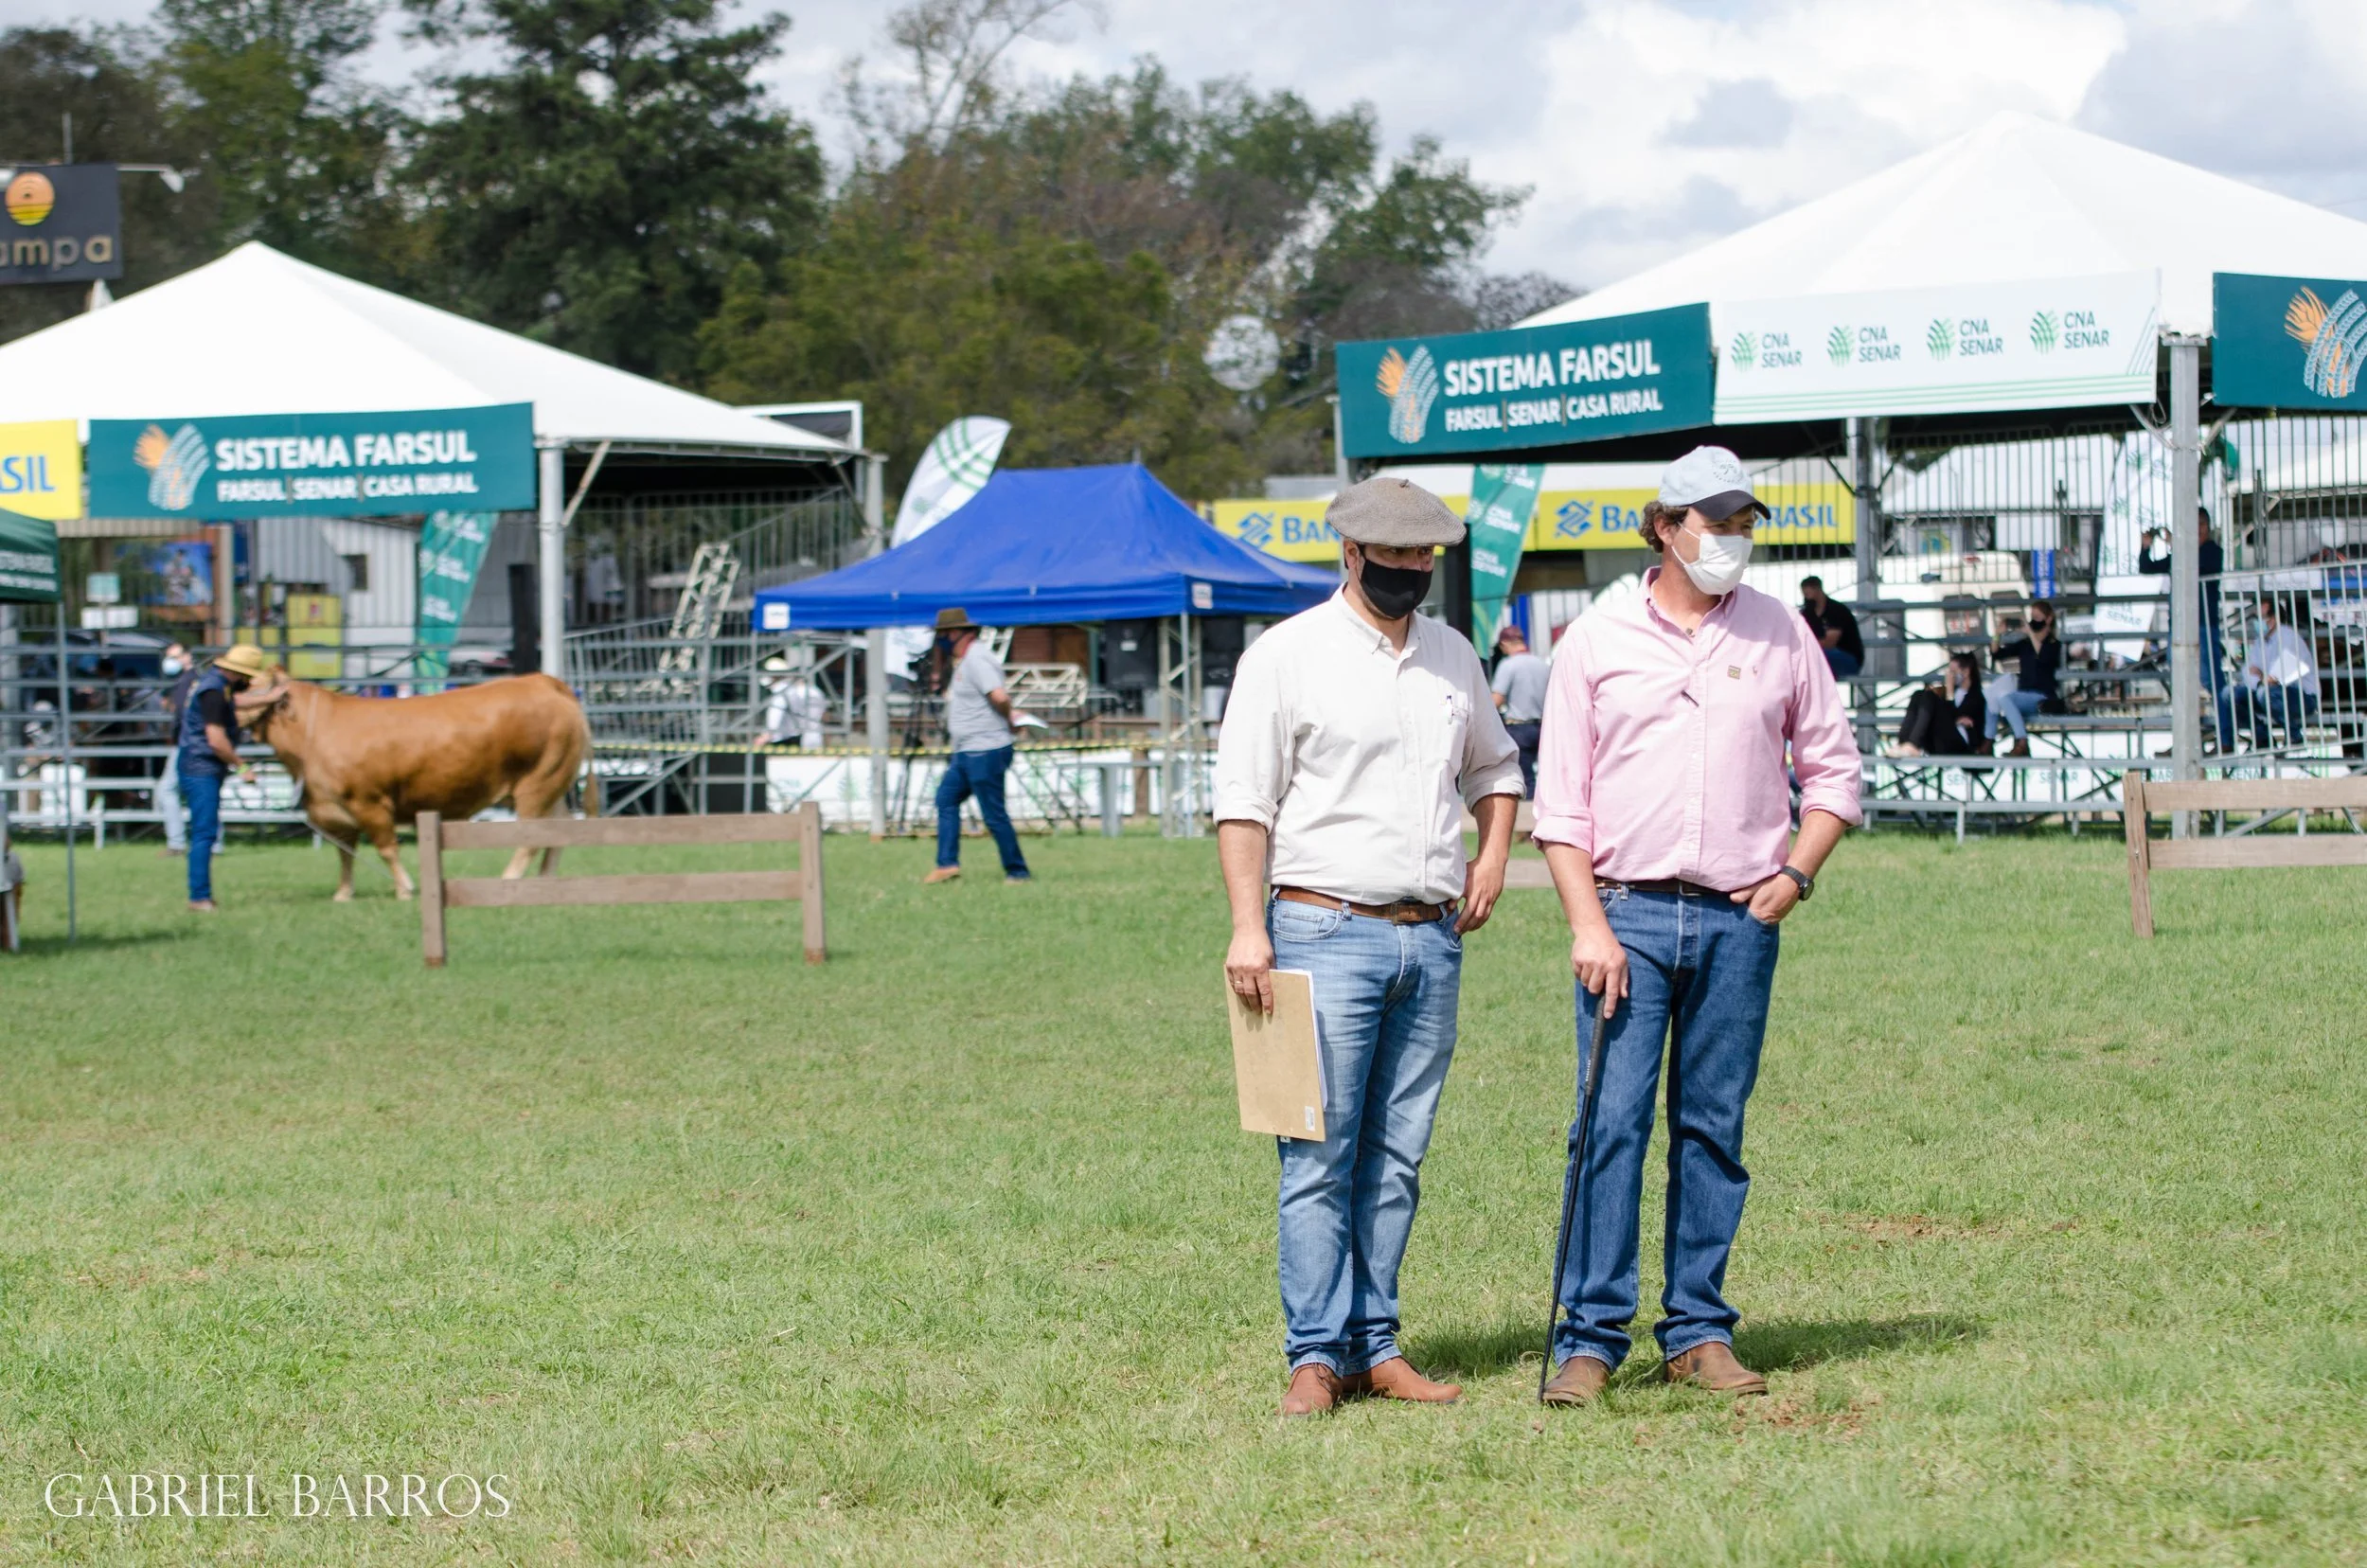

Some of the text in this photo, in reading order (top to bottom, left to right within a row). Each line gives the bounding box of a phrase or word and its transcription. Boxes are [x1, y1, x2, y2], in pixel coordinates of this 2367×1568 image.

[1959, 318, 1989, 336] CNA
[2064, 310, 2095, 329] CNA
[1762, 332, 1790, 349] CNA
[1859, 326, 1888, 343] CNA
[2064, 329, 2109, 349] SENAR
[1859, 345, 1901, 363] SENAR
[1959, 337, 2003, 356] SENAR
[1444, 338, 1661, 397] SISTEMA FARSUL
[1761, 350, 1803, 368] SENAR
[1445, 387, 1663, 432] FARSUL SENAR CASA RURAL
[215, 430, 477, 472] SISTEMA FARSUL
[217, 471, 479, 502] FARSUL SENAR CASA RURAL
